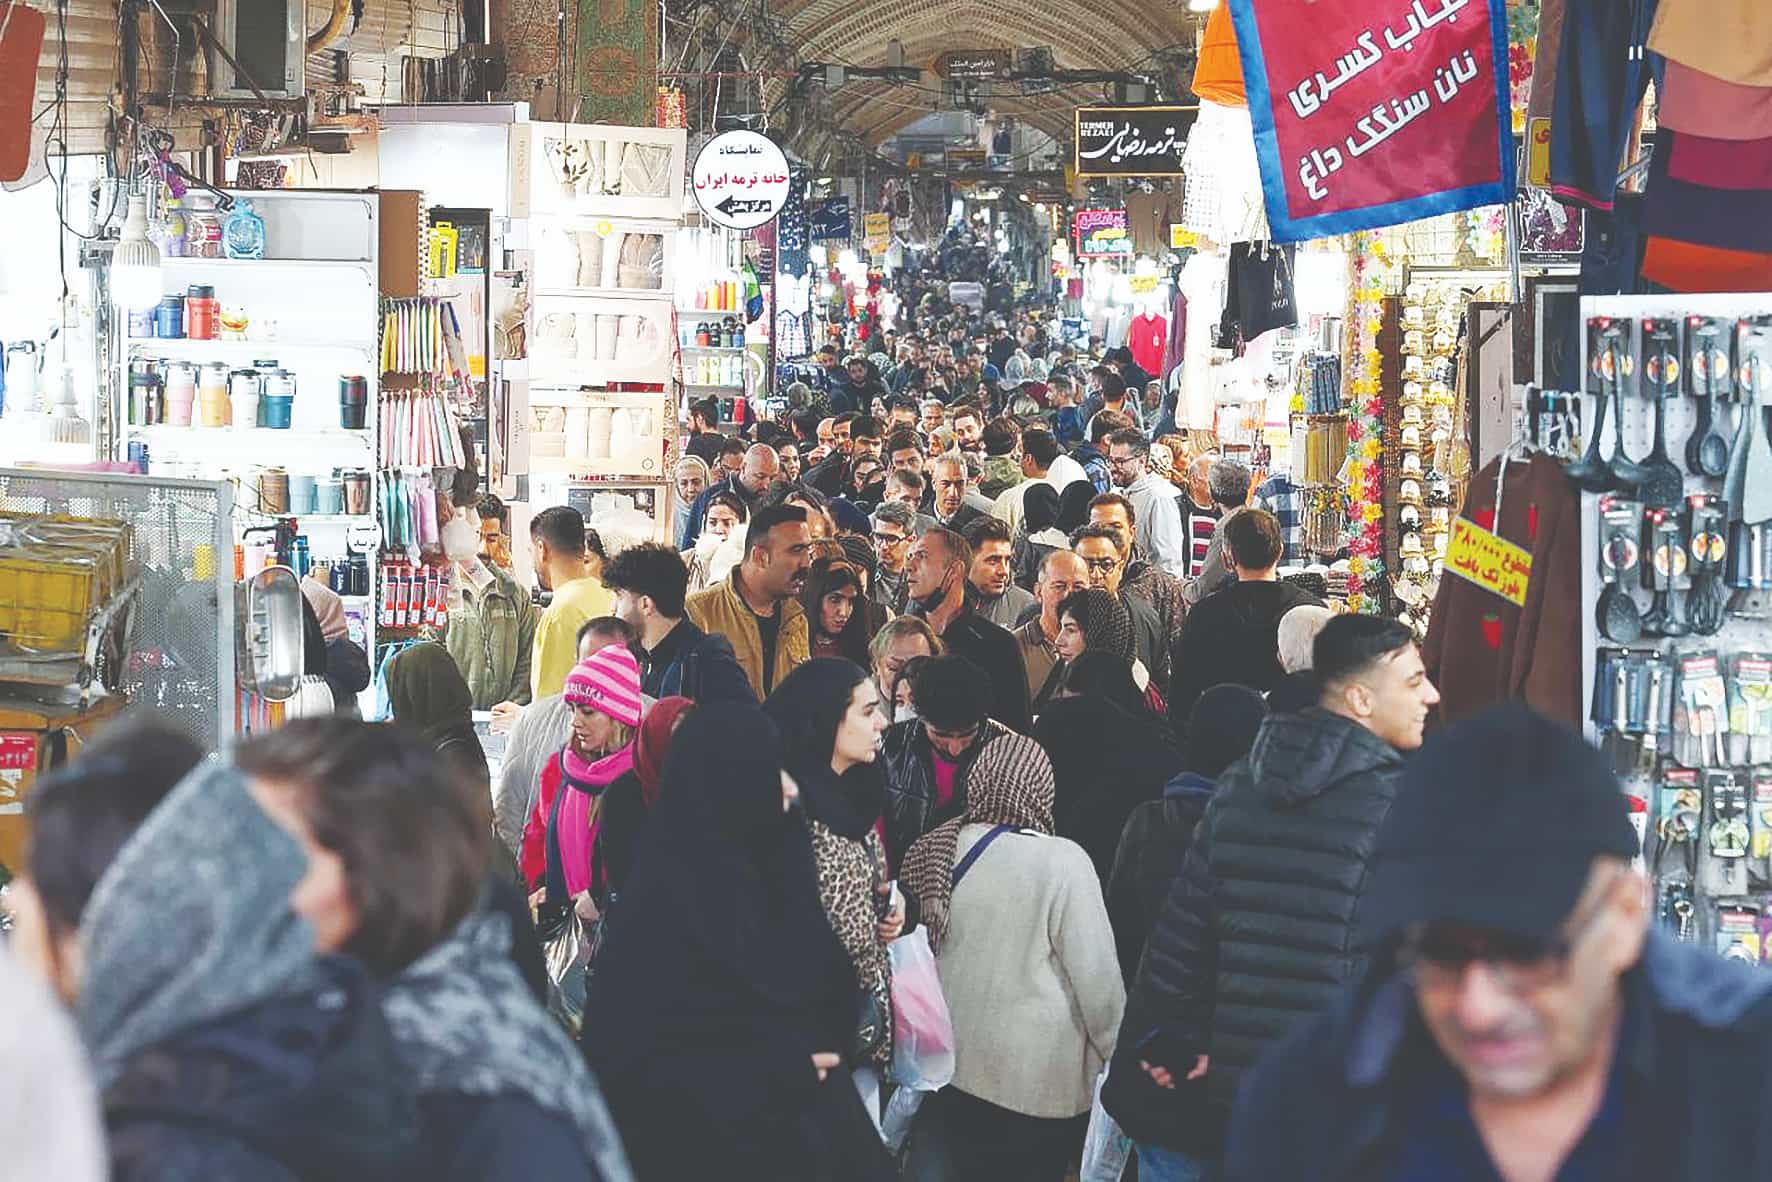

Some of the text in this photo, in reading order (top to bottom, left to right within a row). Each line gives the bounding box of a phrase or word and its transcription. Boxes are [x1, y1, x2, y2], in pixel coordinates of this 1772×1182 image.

[1288, 0, 1470, 119] باب کسری
[1079, 121, 1114, 129] TERMEH
[1299, 49, 1478, 201] نان سنگک داغ
[719, 144, 763, 156] نمایشگاه
[1144, 126, 1175, 156] ترمه
[696, 171, 788, 190] خانه ترمه ایران
